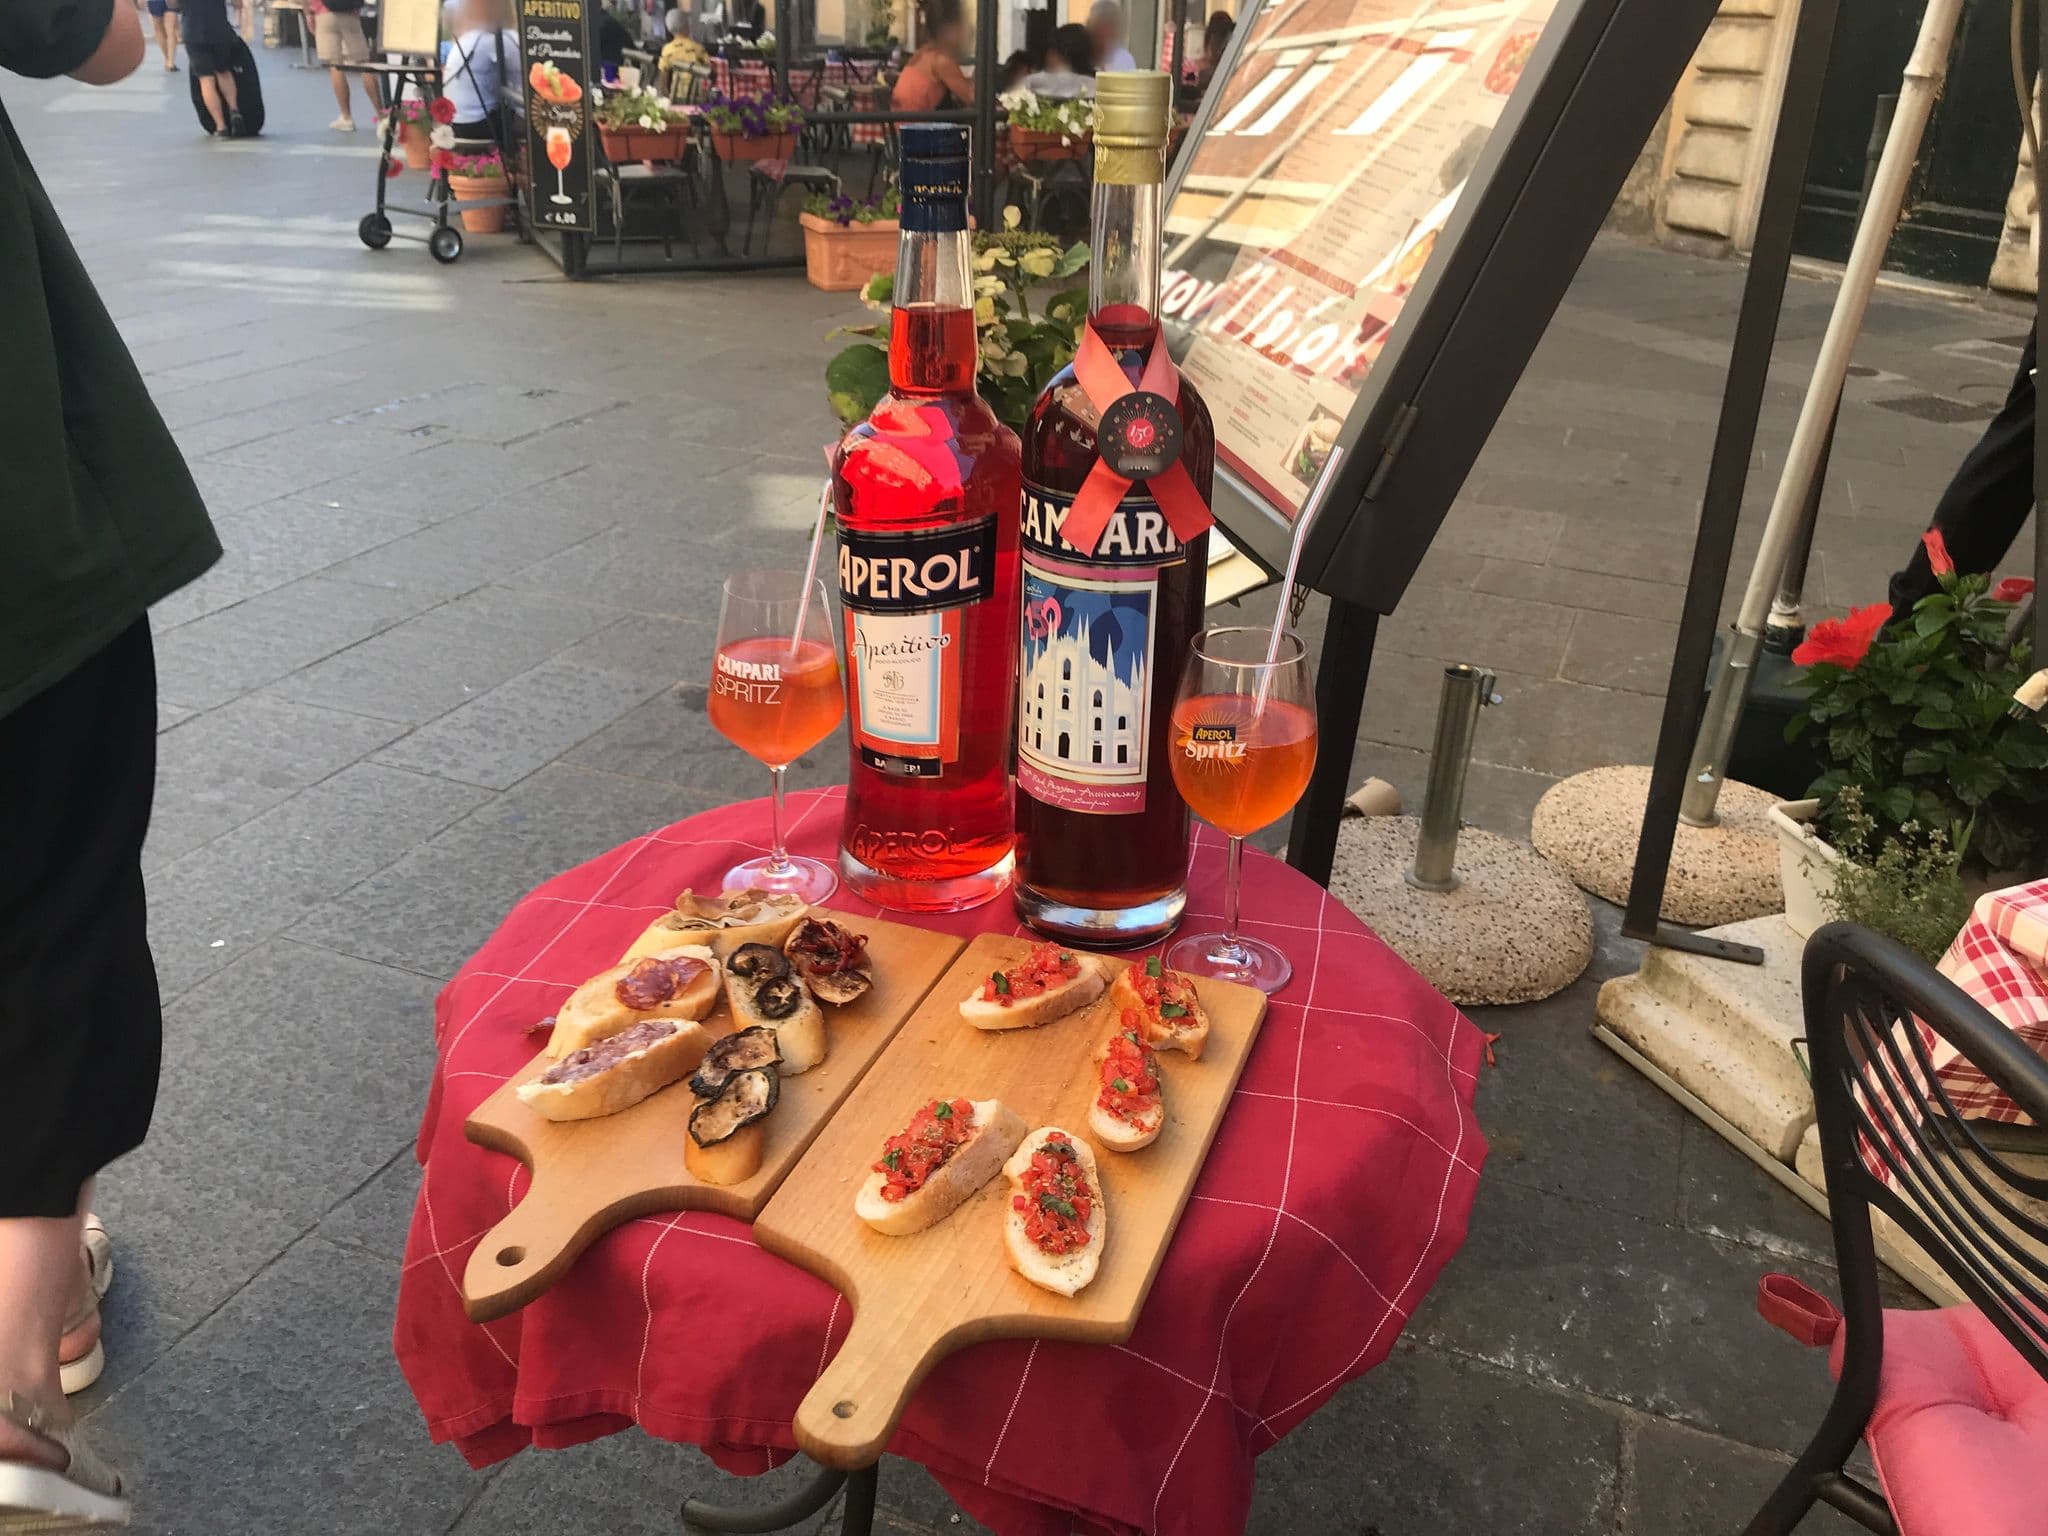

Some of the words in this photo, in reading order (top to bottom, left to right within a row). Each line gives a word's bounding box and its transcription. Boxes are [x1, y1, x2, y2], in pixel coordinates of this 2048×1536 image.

[524, 1, 580, 19] APERITIVO
[1020, 488, 1177, 556] CAMARI
[838, 544, 980, 599] APEROL
[1025, 597, 1062, 640] 150
[851, 628, 951, 670] Aperitivo
[718, 653, 782, 681] CAMPARI
[715, 674, 781, 704] SPRITZ
[1195, 728, 1233, 740] APEROL
[1185, 741, 1247, 761] Spritz
[853, 824, 966, 860] APEROL
